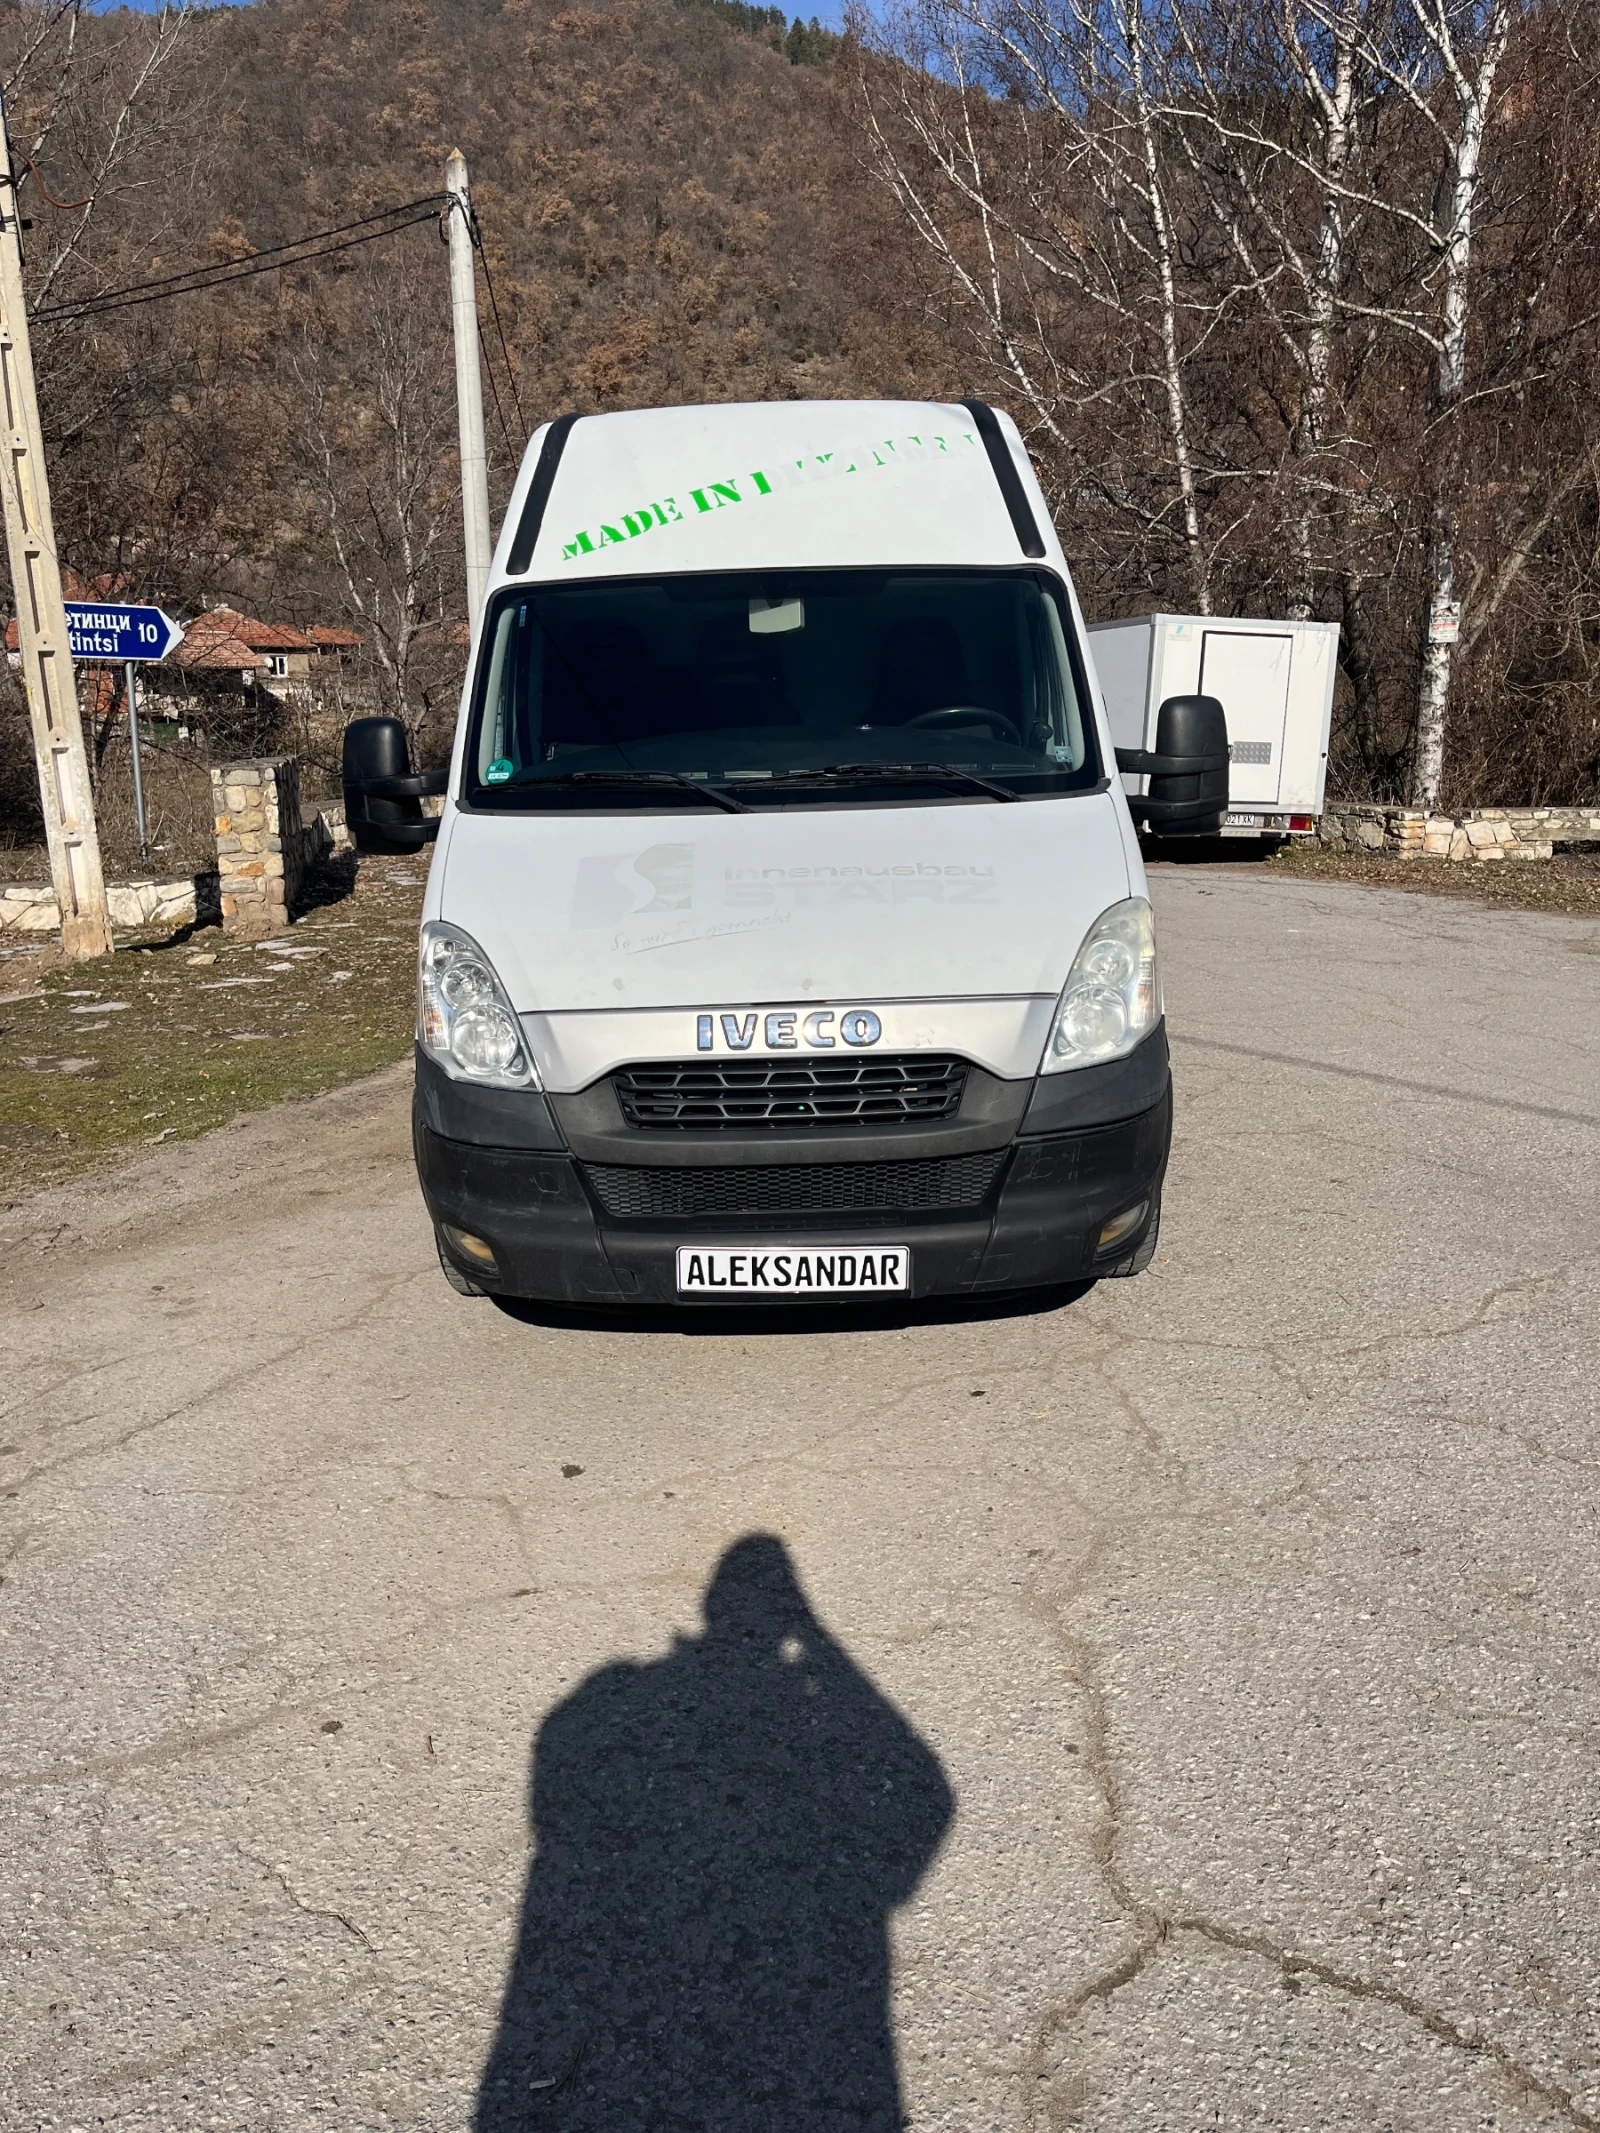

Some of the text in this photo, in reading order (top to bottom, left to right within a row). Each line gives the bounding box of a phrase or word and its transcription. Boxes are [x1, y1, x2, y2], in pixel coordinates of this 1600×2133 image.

[562, 497, 684, 561] MADE
[688, 478, 743, 513] IN
[69, 630, 119, 653] tintsi
[138, 622, 158, 643] 10
[496, 760, 505, 772] 4
[724, 880, 1000, 908] STARZ
[696, 1009, 883, 1051] IVECO
[687, 1254, 900, 1287] ALEKSANDAR
